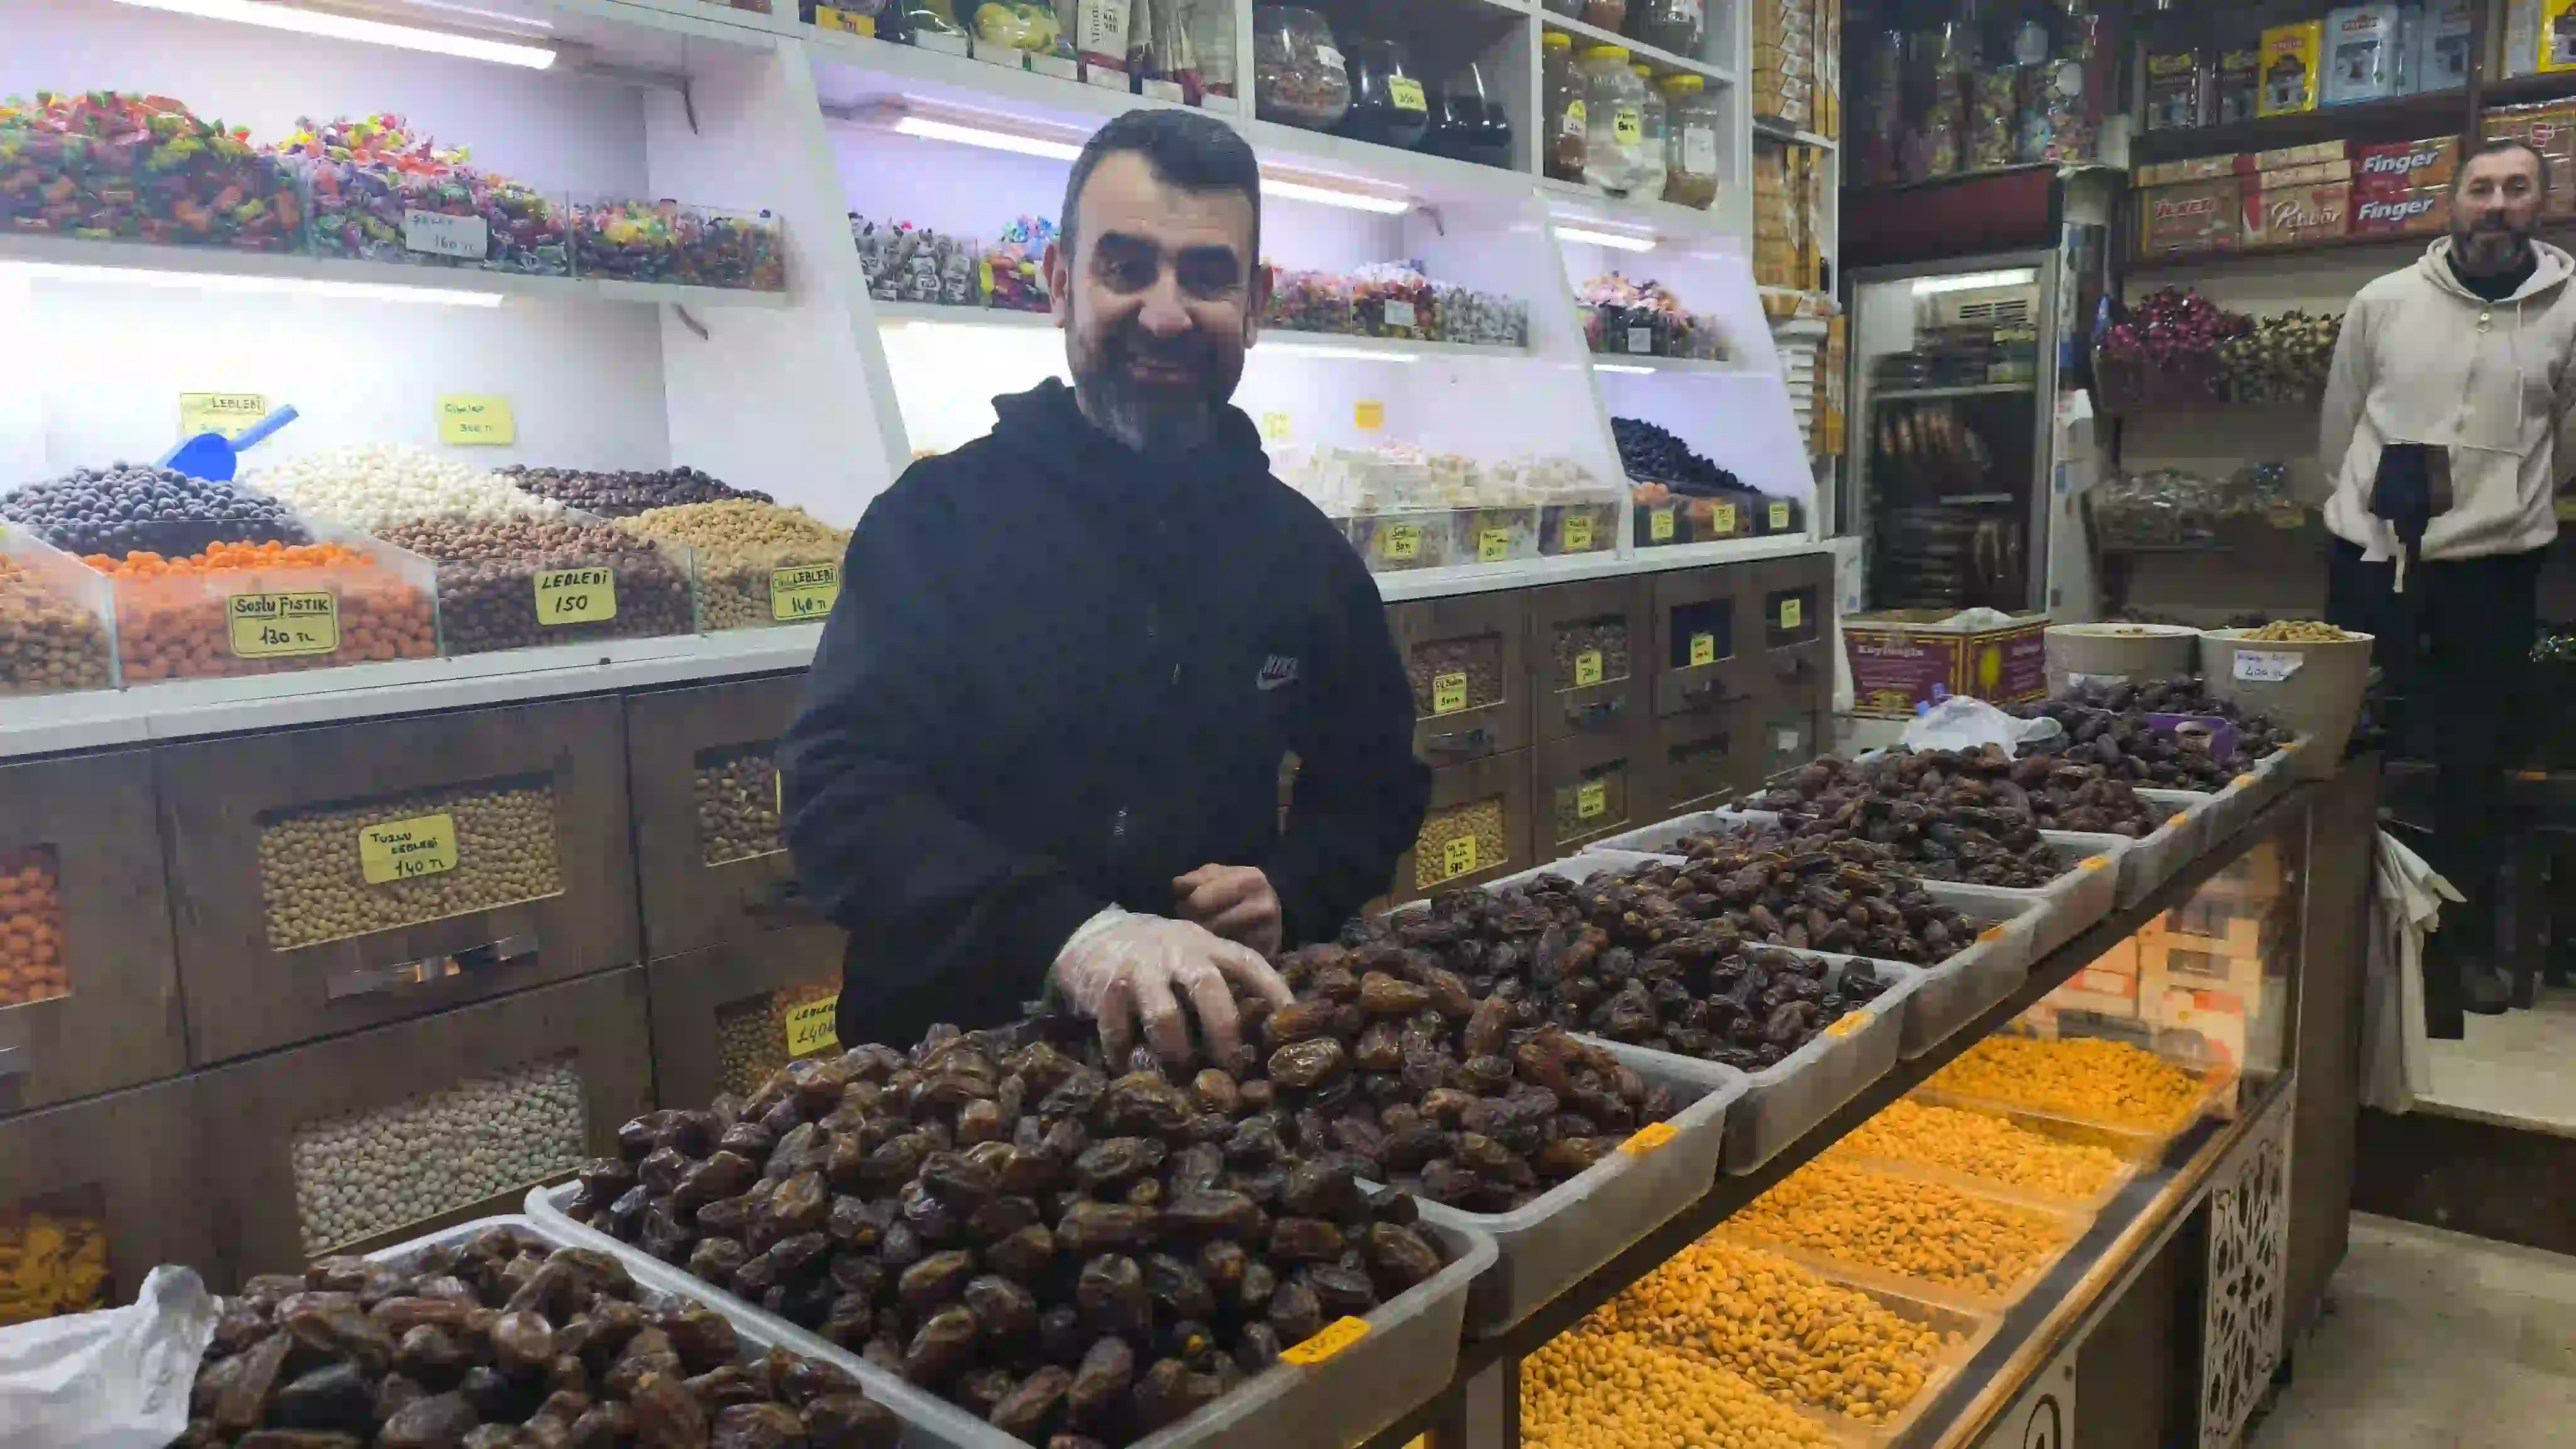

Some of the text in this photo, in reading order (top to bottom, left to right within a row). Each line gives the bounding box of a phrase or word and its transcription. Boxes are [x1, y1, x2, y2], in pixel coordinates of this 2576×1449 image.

[2363, 152, 2438, 174] Finger
[2358, 199, 2434, 221] Finger
[542, 570, 608, 589] LEBLEBİ
[793, 568, 834, 584] LEBLEBİ
[556, 595, 587, 613] 150
[296, 632, 316, 642] TL
[395, 860, 424, 877] 140
